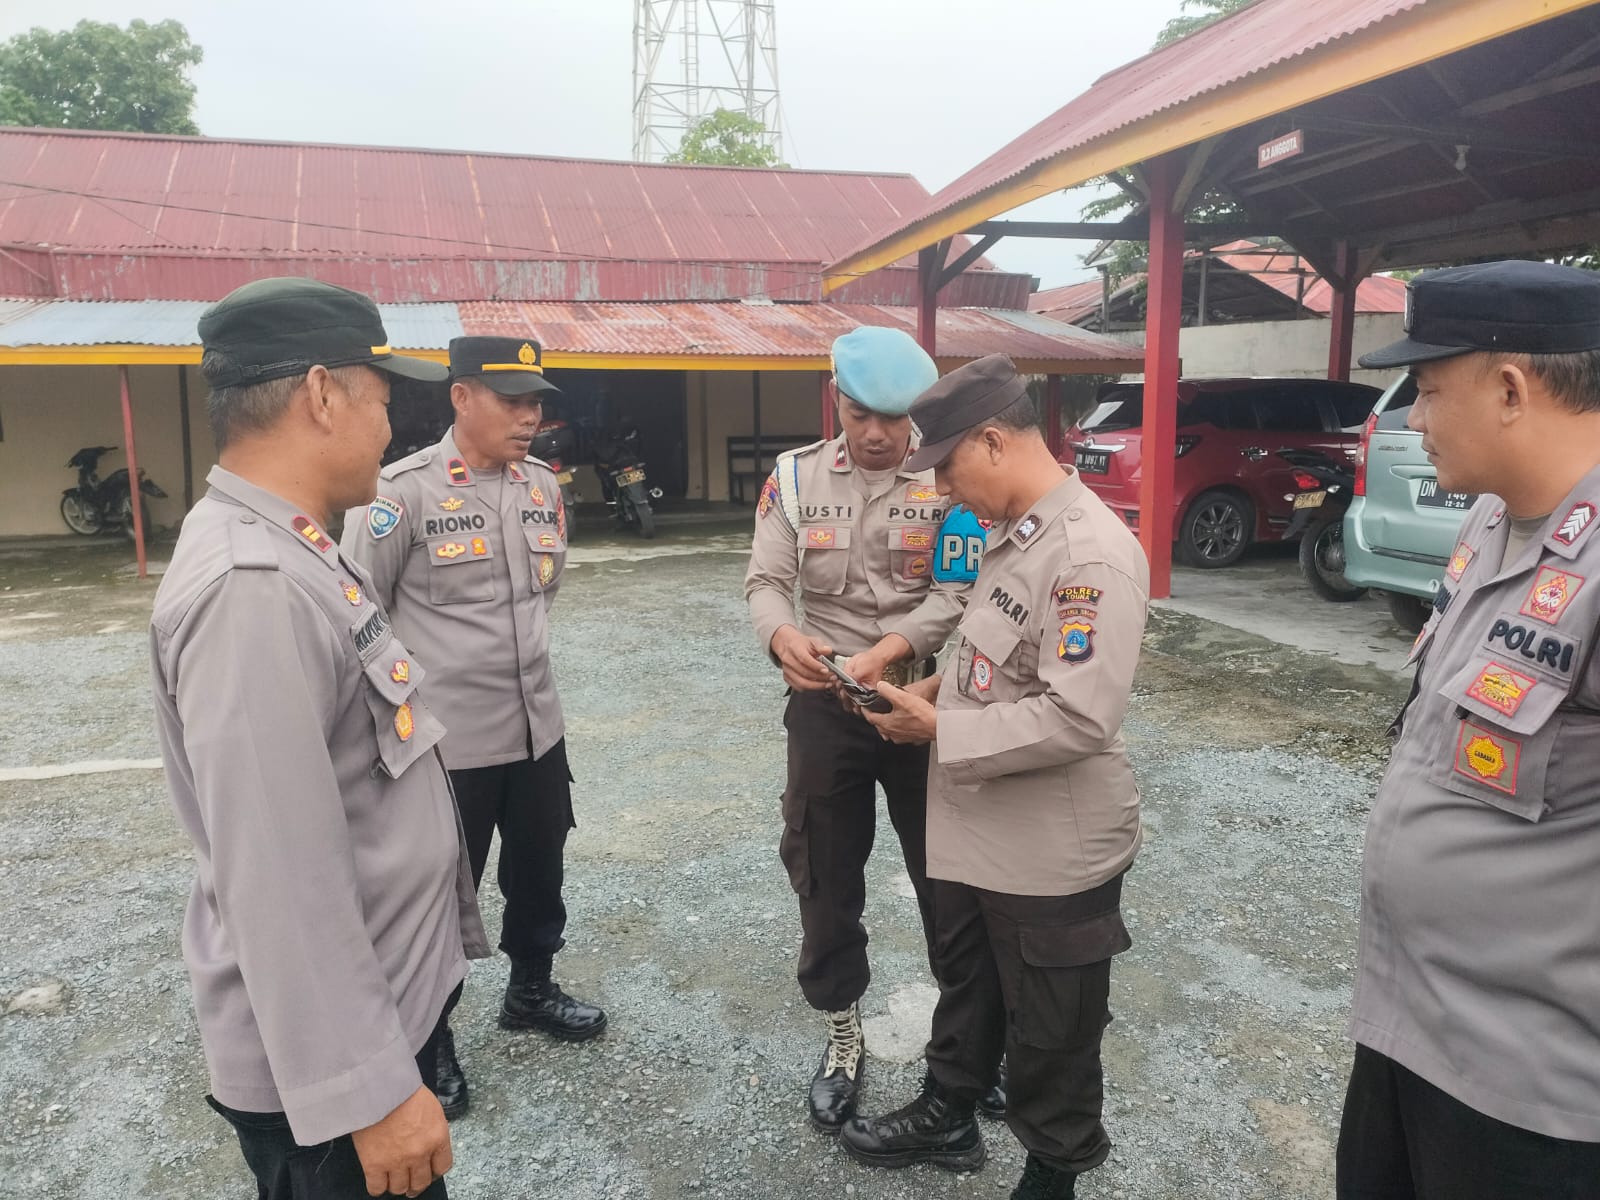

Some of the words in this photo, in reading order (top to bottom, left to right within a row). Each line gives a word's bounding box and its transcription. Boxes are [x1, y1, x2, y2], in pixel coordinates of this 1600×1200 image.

[1420, 480, 1438, 498] DN
[425, 513, 486, 535] RIONO
[1057, 587, 1099, 598] POLRES
[989, 586, 1029, 626] POLRI
[1487, 618, 1575, 674] POLRI
